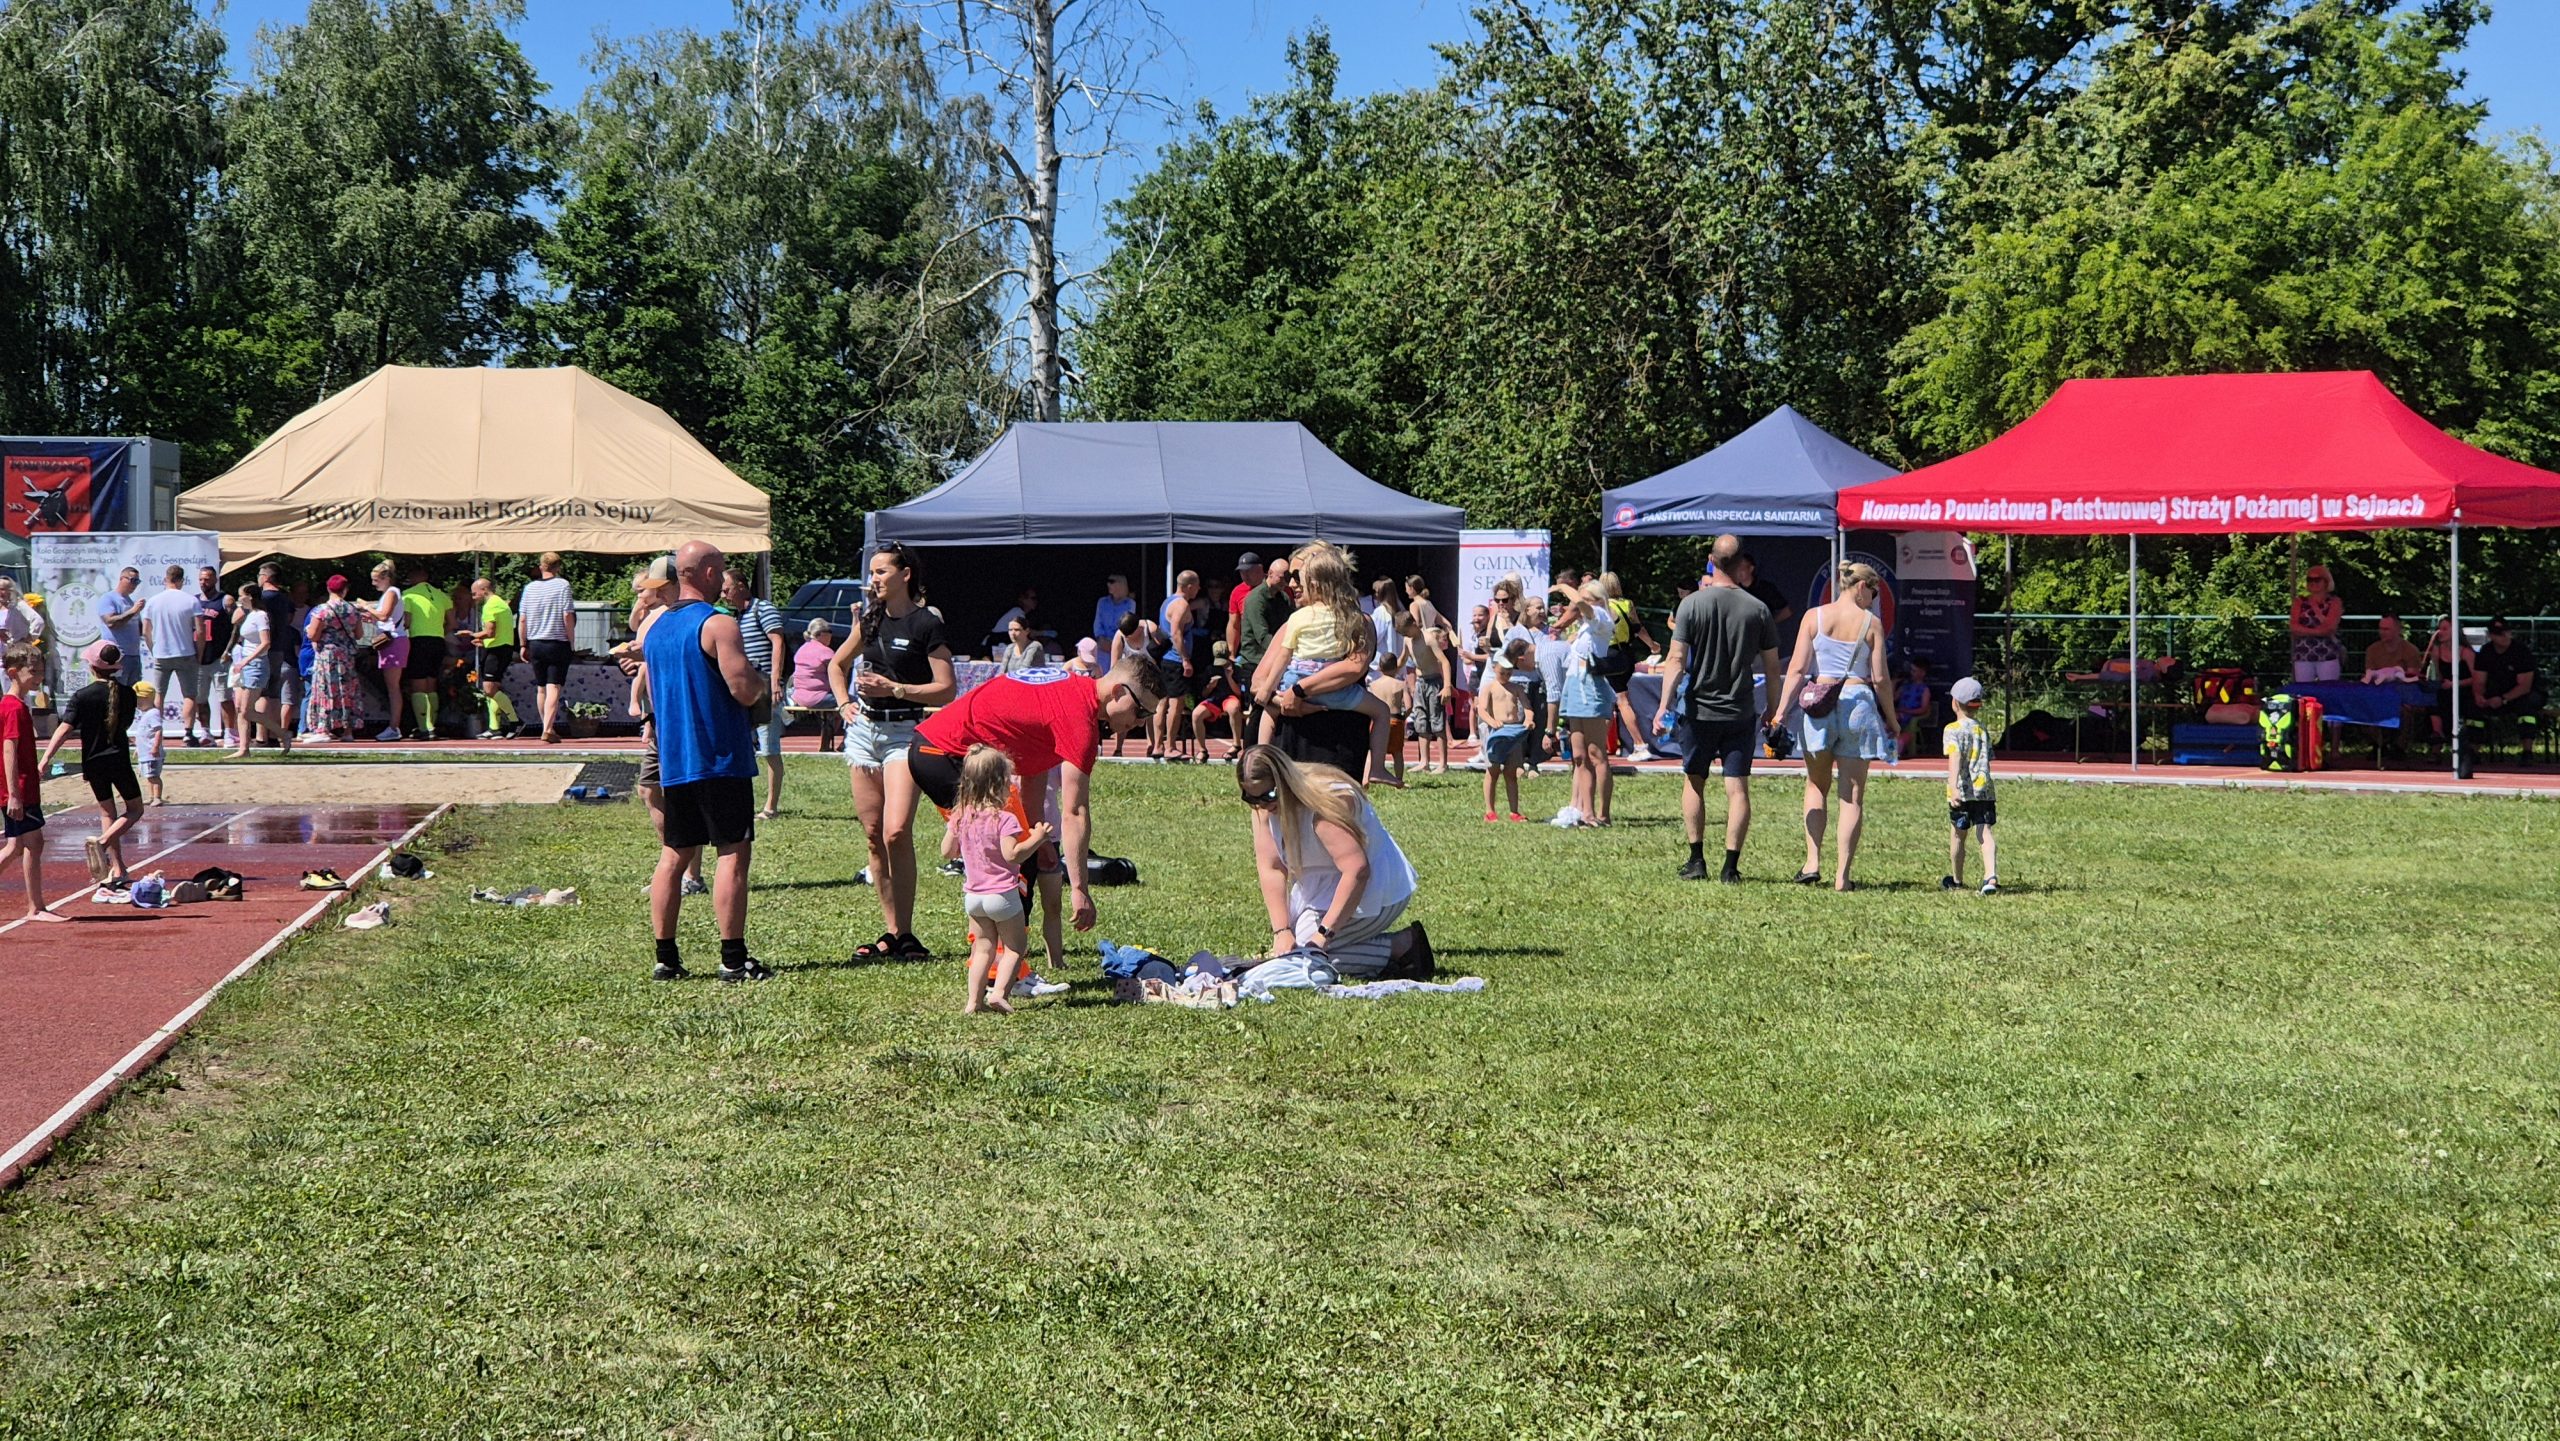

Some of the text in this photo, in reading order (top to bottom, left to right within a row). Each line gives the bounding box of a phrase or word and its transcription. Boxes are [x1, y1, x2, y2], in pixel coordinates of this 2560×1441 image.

[306, 499, 656, 524] KGW Jezioranki Kolonia Sejny
[1707, 510, 1762, 521] INSPEKCJA
[1764, 510, 1822, 521] SANITARNA
[1860, 493, 2425, 525] Komenda Powiatowa Państwowej Straży Pożarnej w Sejnach
[132, 553, 156, 566] Koło
[1474, 556, 1536, 572] GMINA
[1474, 575, 1534, 590] SEY
